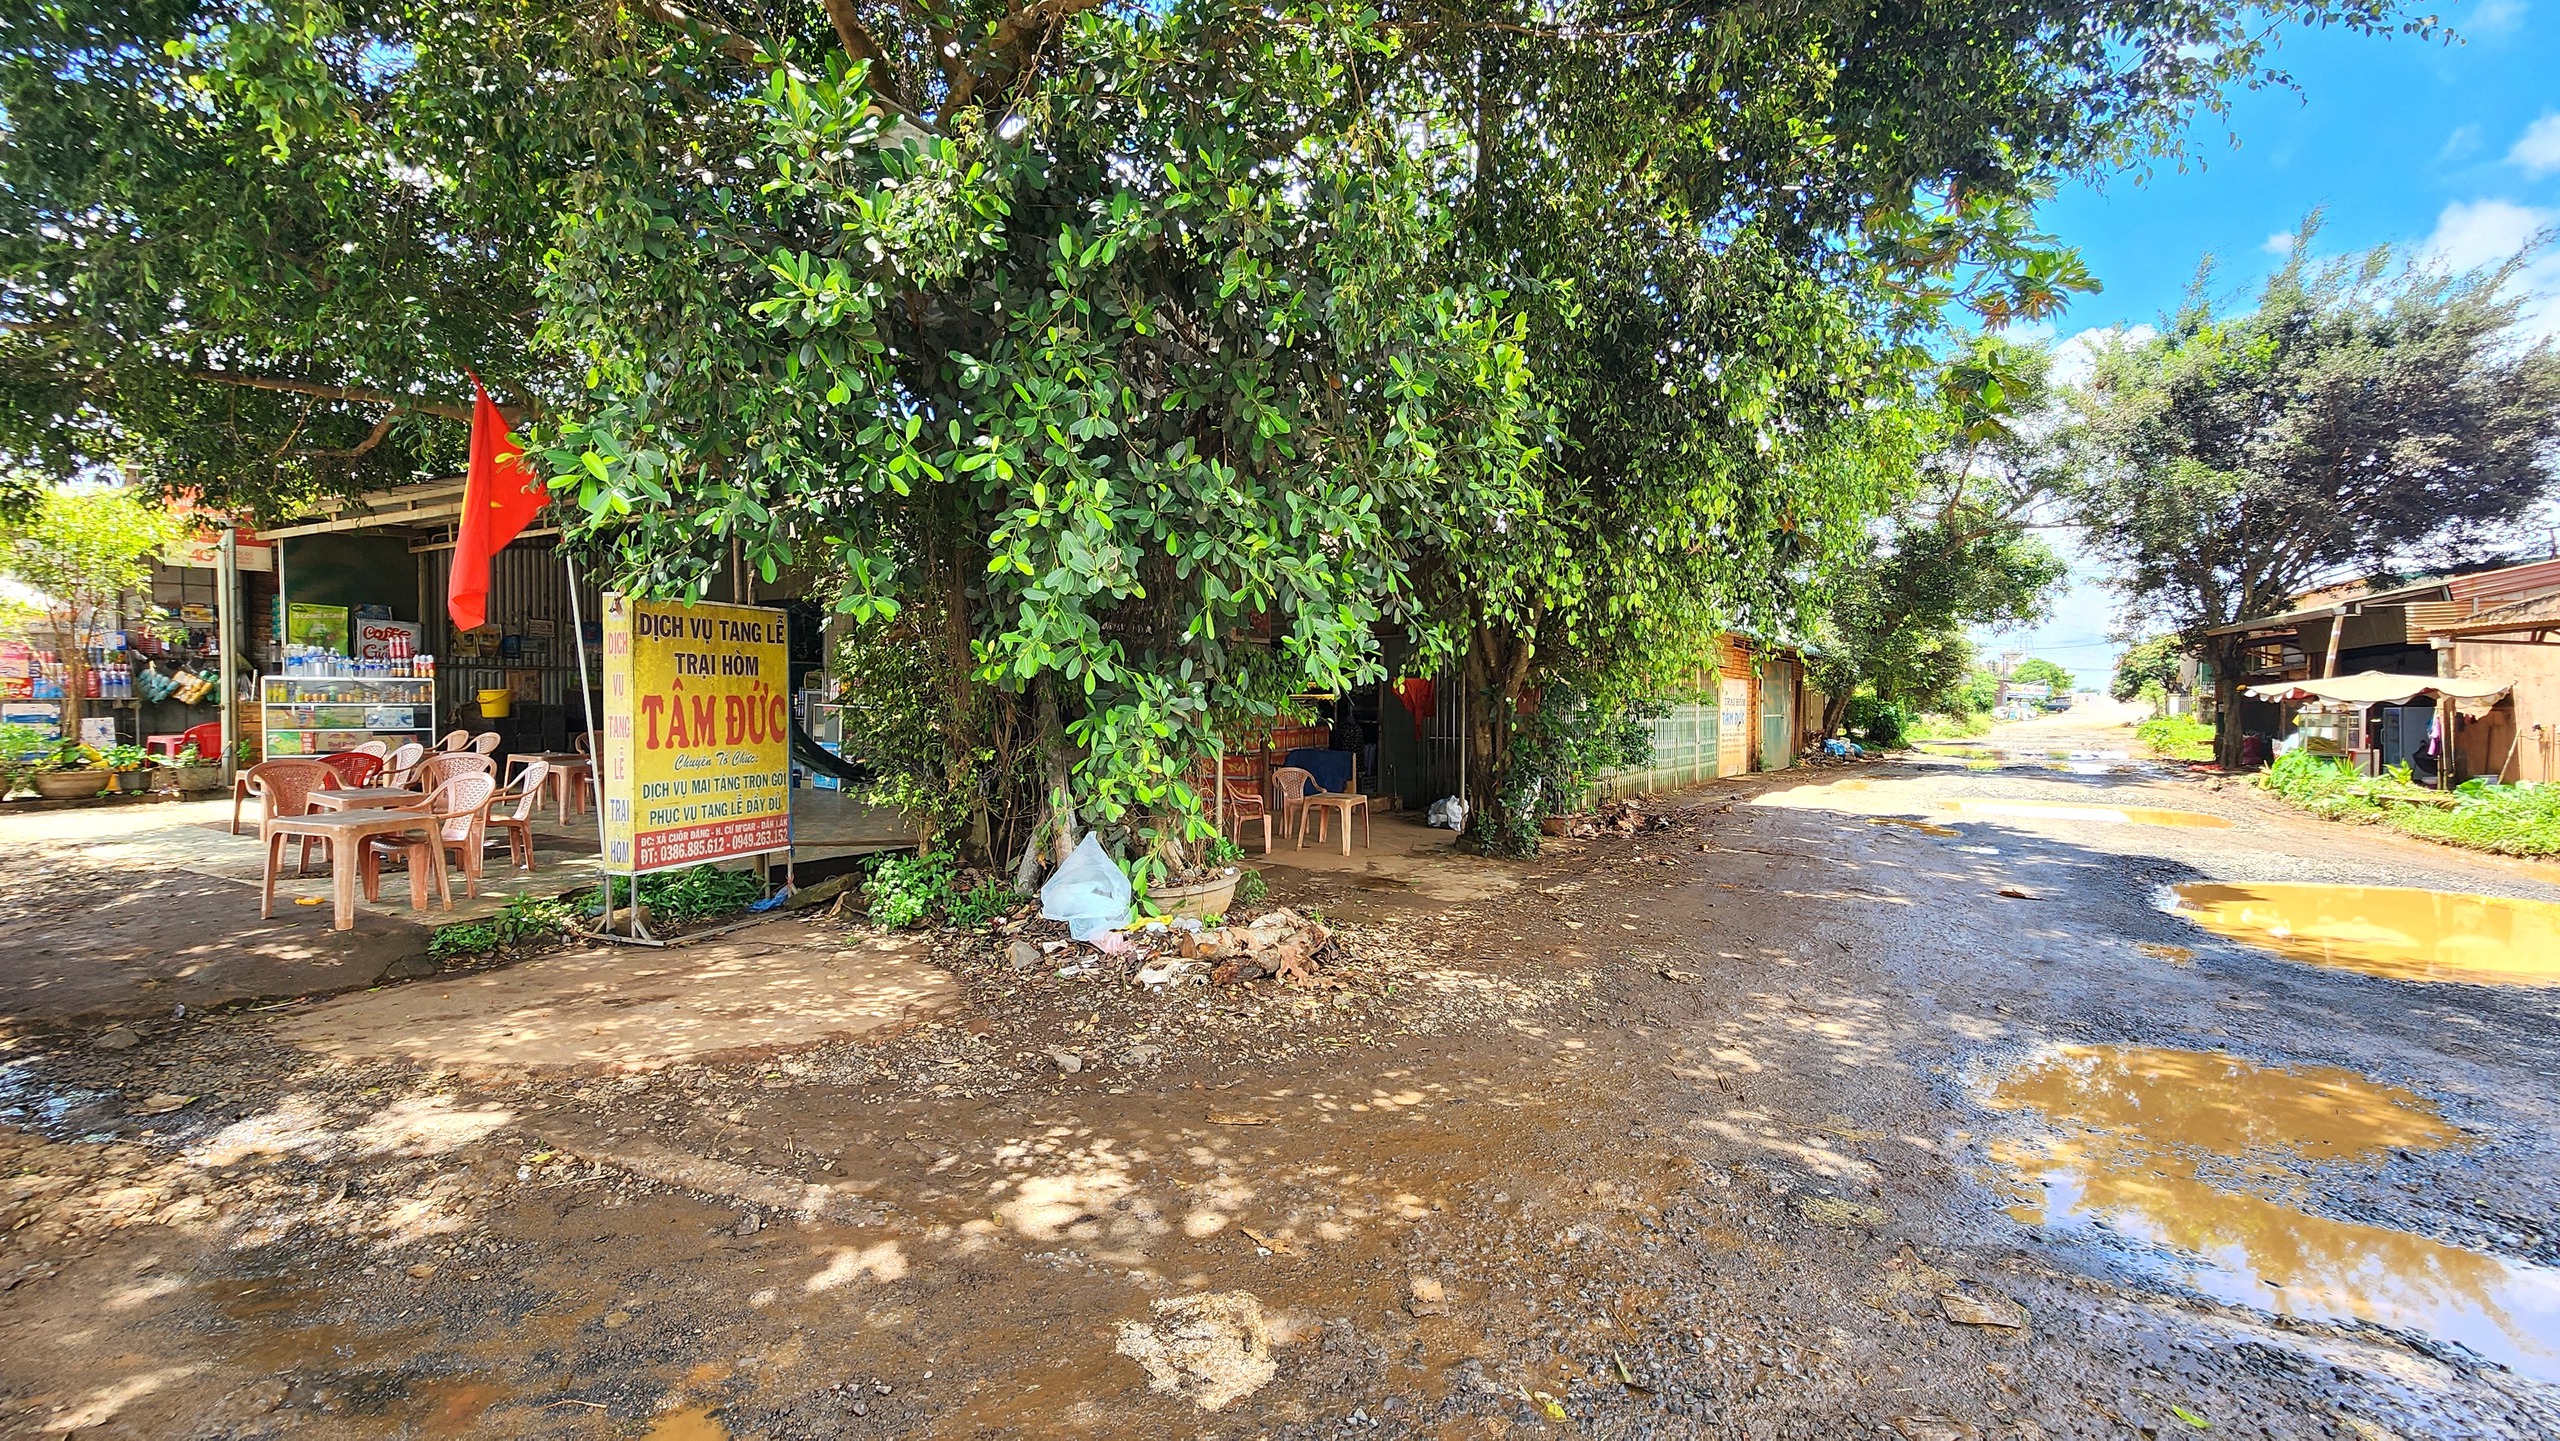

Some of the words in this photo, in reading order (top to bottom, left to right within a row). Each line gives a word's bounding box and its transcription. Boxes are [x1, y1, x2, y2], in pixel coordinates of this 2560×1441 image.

[640, 613, 684, 642] DỊCH
[690, 618, 713, 644] VỤ
[719, 620, 762, 643] TANG
[767, 615, 785, 644] LỄ
[608, 632, 628, 660] DỊCH
[674, 653, 716, 679] TRẠI
[722, 650, 759, 676] HÒM
[613, 674, 624, 701] VỤ
[608, 715, 630, 739] TANG
[642, 677, 717, 750] TÂM
[725, 679, 786, 745] ĐỨC
[614, 747, 625, 780] LỄ
[674, 754, 712, 771] Chuyên
[643, 782, 669, 802] DỊCH
[674, 780, 688, 799] VỤ
[692, 779, 711, 794] MAI
[714, 773, 741, 792] TÁNG
[743, 774, 769, 792] TRỌN
[771, 769, 787, 787] GÓI
[610, 799, 630, 827] TRẠI
[650, 807, 680, 827] PHỤC
[684, 805, 698, 823] VỤ
[701, 803, 728, 819] TANG
[731, 795, 743, 816] LỄ
[746, 793, 767, 814] ĐẦY
[768, 792, 782, 811] ĐỦ
[610, 835, 630, 864] HÒM
[640, 847, 658, 866] ĐT:
[660, 837, 725, 861] 0386.885.612
[731, 827, 789, 850] 0949.263.152
[641, 836, 655, 847] ĐC:
[656, 833, 667, 845] XÃ
[715, 827, 723, 836] H.
